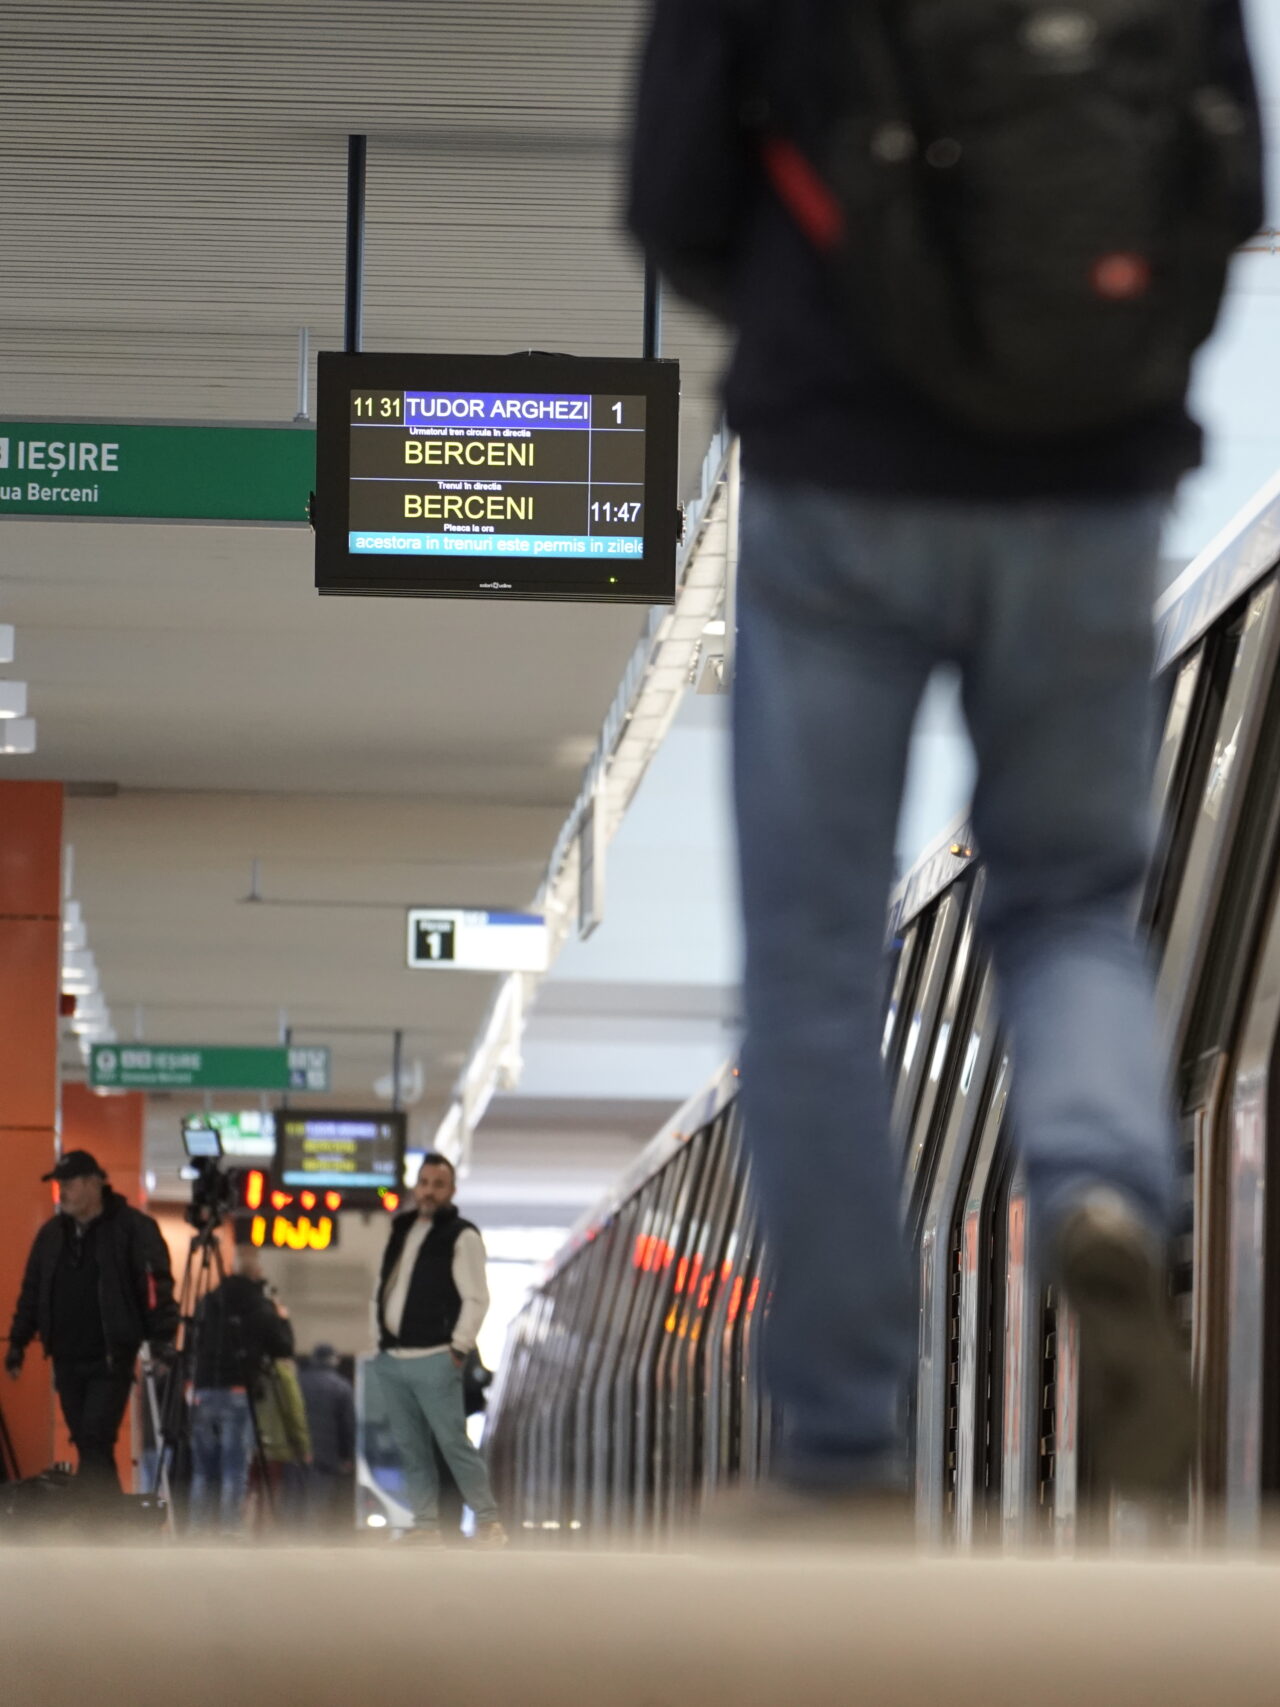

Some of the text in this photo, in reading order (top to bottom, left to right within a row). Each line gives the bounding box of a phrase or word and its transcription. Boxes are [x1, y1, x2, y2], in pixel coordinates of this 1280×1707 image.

[353, 397, 401, 417] 11 31
[406, 398, 589, 420] TUDOR ARGHEZI
[611, 402, 623, 424] 1
[18, 440, 119, 478] IEȘIRE
[404, 440, 535, 467] BERCENI
[28, 482, 99, 503] Berceni
[437, 481, 463, 491] Trenul
[404, 494, 534, 520] BERCENI
[591, 501, 642, 523] 11:47
[481, 525, 495, 534] ora
[355, 535, 422, 550] acestora
[426, 535, 440, 550] in
[444, 535, 493, 551] trenuri
[496, 537, 530, 551] este
[533, 537, 586, 555] permis
[590, 538, 604, 553] in
[426, 932, 441, 960] 1
